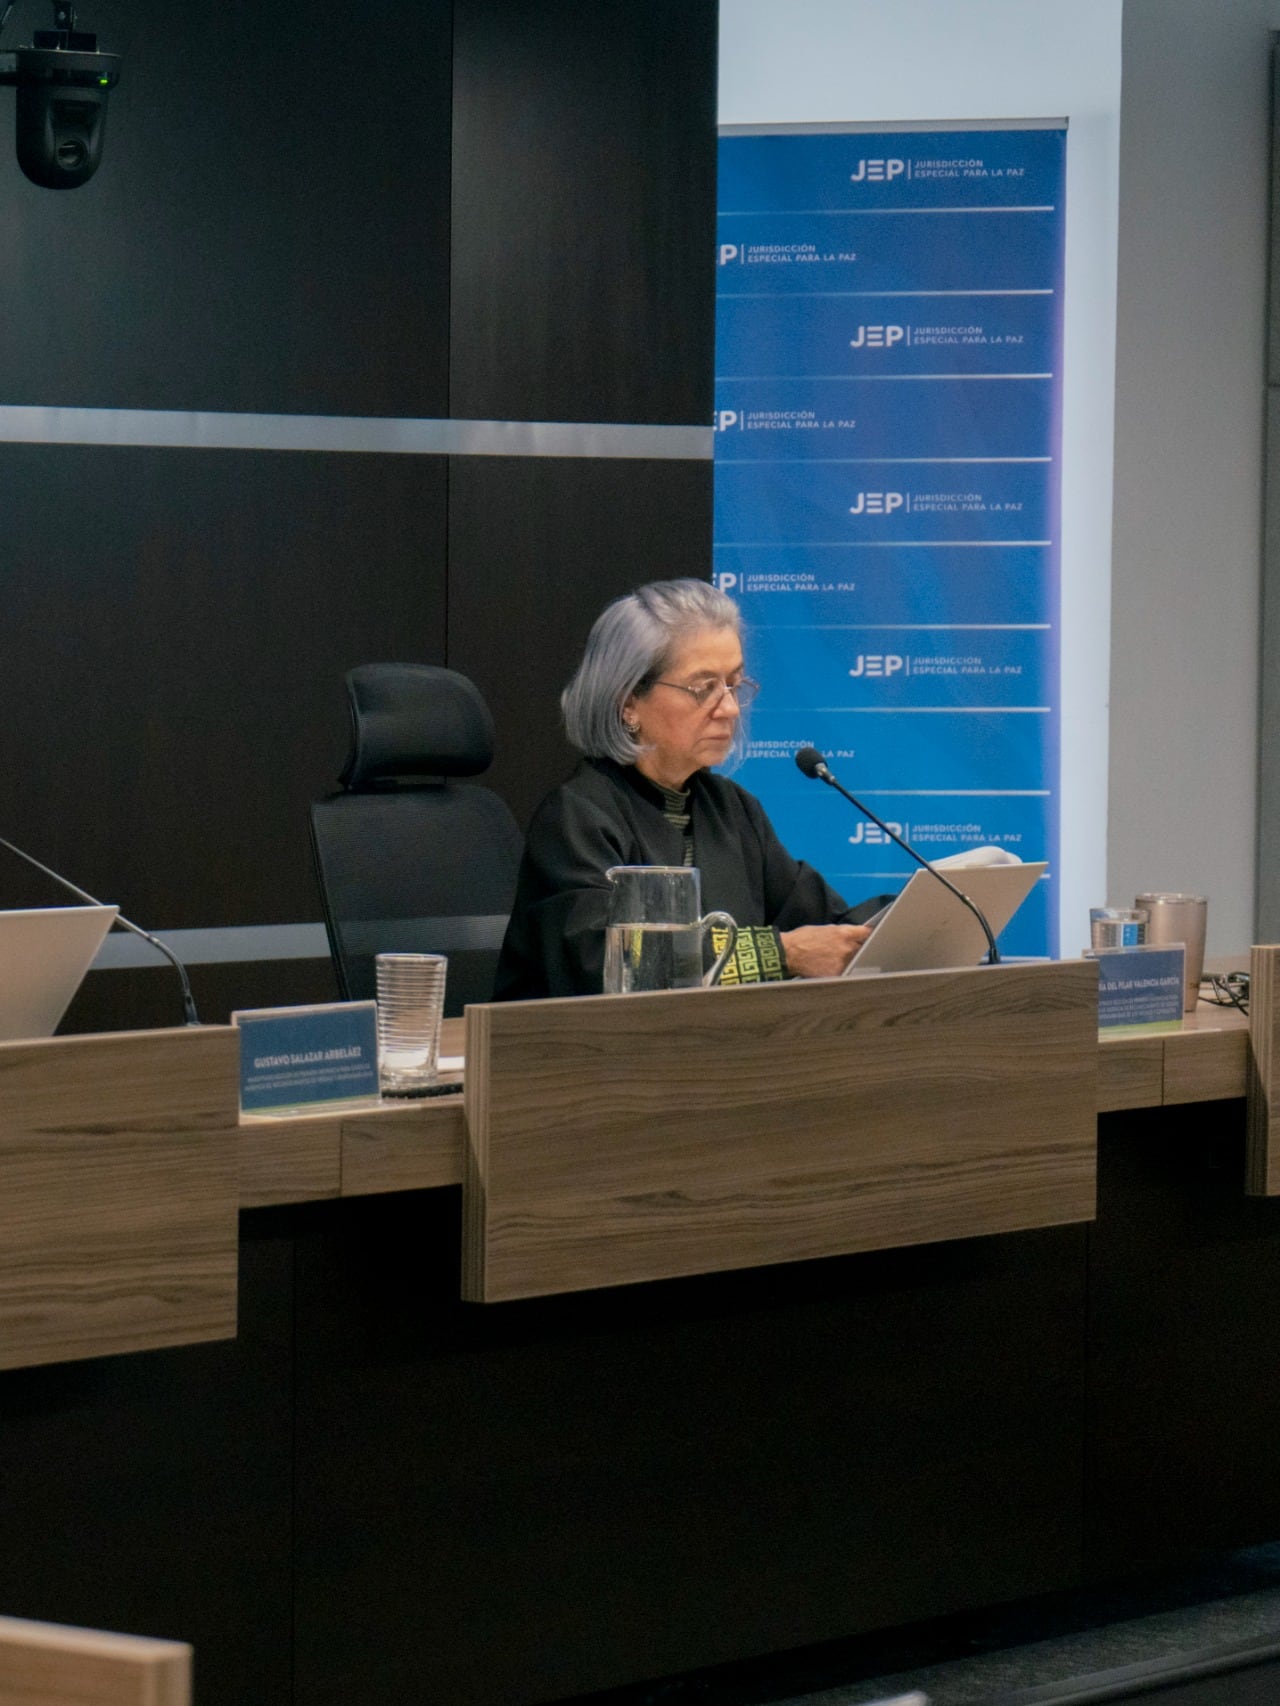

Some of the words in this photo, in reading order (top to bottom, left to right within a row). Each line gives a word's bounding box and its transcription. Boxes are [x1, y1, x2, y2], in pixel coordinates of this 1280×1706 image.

[914, 159, 983, 168] JURISDICCIÓN
[851, 160, 905, 181] JEP
[914, 170, 960, 178] ESPECIAL
[963, 169, 988, 177] PARA
[991, 169, 1003, 177] LA
[1006, 168, 1025, 176] PAZ
[747, 244, 816, 253] JURISDICCIÓN
[747, 254, 792, 263] ESPECIAL
[795, 254, 820, 262] PARA
[823, 254, 836, 262] LA
[838, 253, 857, 261] PAZ
[913, 326, 983, 335] JURISDICCIÓN
[850, 326, 904, 347] JEP
[913, 336, 959, 344] ESPECIAL
[962, 336, 987, 344] PARA
[990, 336, 1002, 344] LA
[1005, 335, 1024, 343] PAZ
[747, 410, 816, 419] JURISDICCIÓN
[747, 420, 792, 429] ESPECIAL
[795, 420, 820, 429] PARA
[823, 420, 835, 428] LA
[837, 420, 856, 428] PAZ
[913, 493, 982, 502] JURISDICCIÓN
[849, 493, 903, 514] JEP
[913, 503, 958, 511] ESPECIAL
[961, 503, 987, 511] PARA
[989, 503, 1002, 511] LA
[747, 573, 815, 583] JURISDICCIÓN
[747, 583, 791, 592] ESPECIAL
[794, 583, 819, 591] PARA
[822, 583, 835, 591] LA
[837, 583, 855, 591] PAZ
[913, 656, 982, 665] JURISDICCIÓN
[849, 656, 903, 677] JEP
[912, 666, 958, 674] ESPECIAL
[961, 666, 986, 674] PARA
[989, 666, 1001, 674] LA
[1004, 666, 1022, 674] PAZ
[746, 750, 790, 758] ESPECIAL
[837, 750, 854, 758] PAZ
[912, 823, 981, 832] JURISDICCIÓN
[849, 822, 903, 844] JEP
[912, 834, 958, 842] ESPECIAL
[961, 834, 986, 842] PARA
[989, 834, 1001, 842] LA
[1004, 834, 1022, 842] PAZ
[254, 1054, 290, 1068] GUSTAVO
[291, 1051, 324, 1064] SALAZAR
